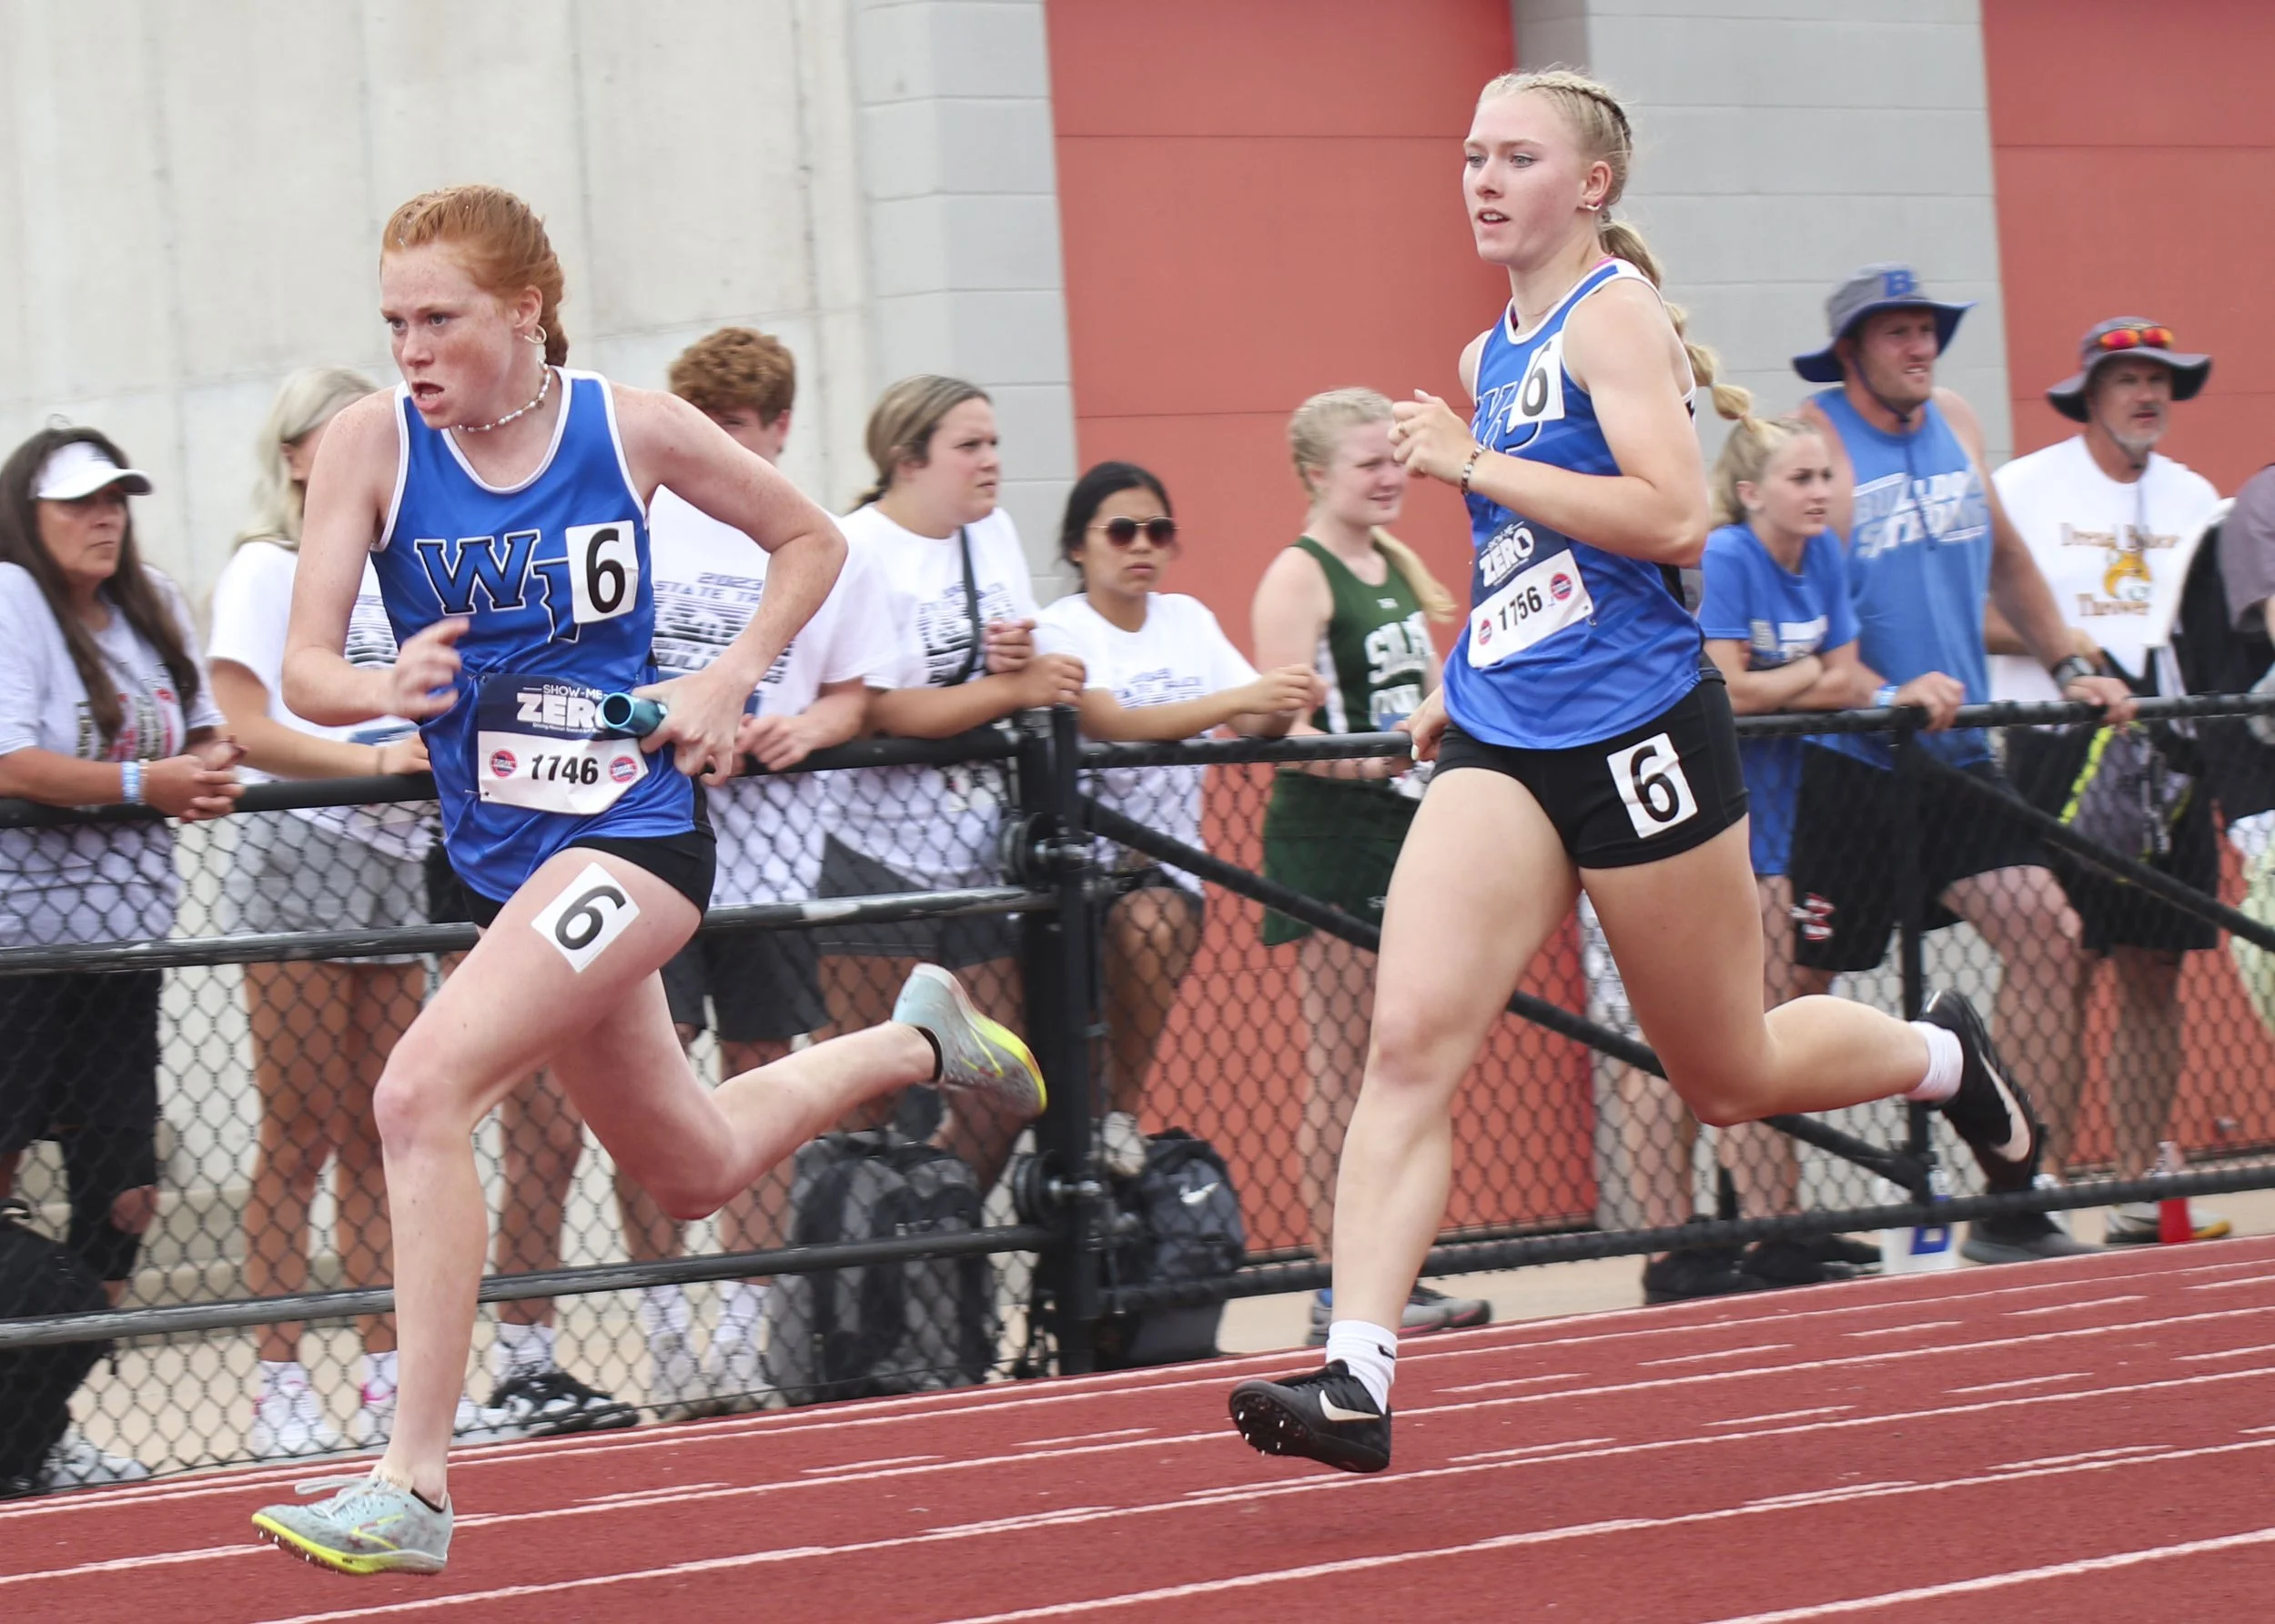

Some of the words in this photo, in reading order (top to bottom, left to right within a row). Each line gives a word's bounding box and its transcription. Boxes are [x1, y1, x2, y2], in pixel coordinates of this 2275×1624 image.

[1521, 340, 1549, 418] 6
[586, 527, 626, 614] 6
[1479, 527, 1535, 588] ZERO
[1498, 585, 1542, 631] 1756
[542, 683, 603, 700] SHOW-ME
[531, 753, 599, 785] 1746
[1630, 744, 1680, 823] 6
[554, 884, 627, 951] 6
